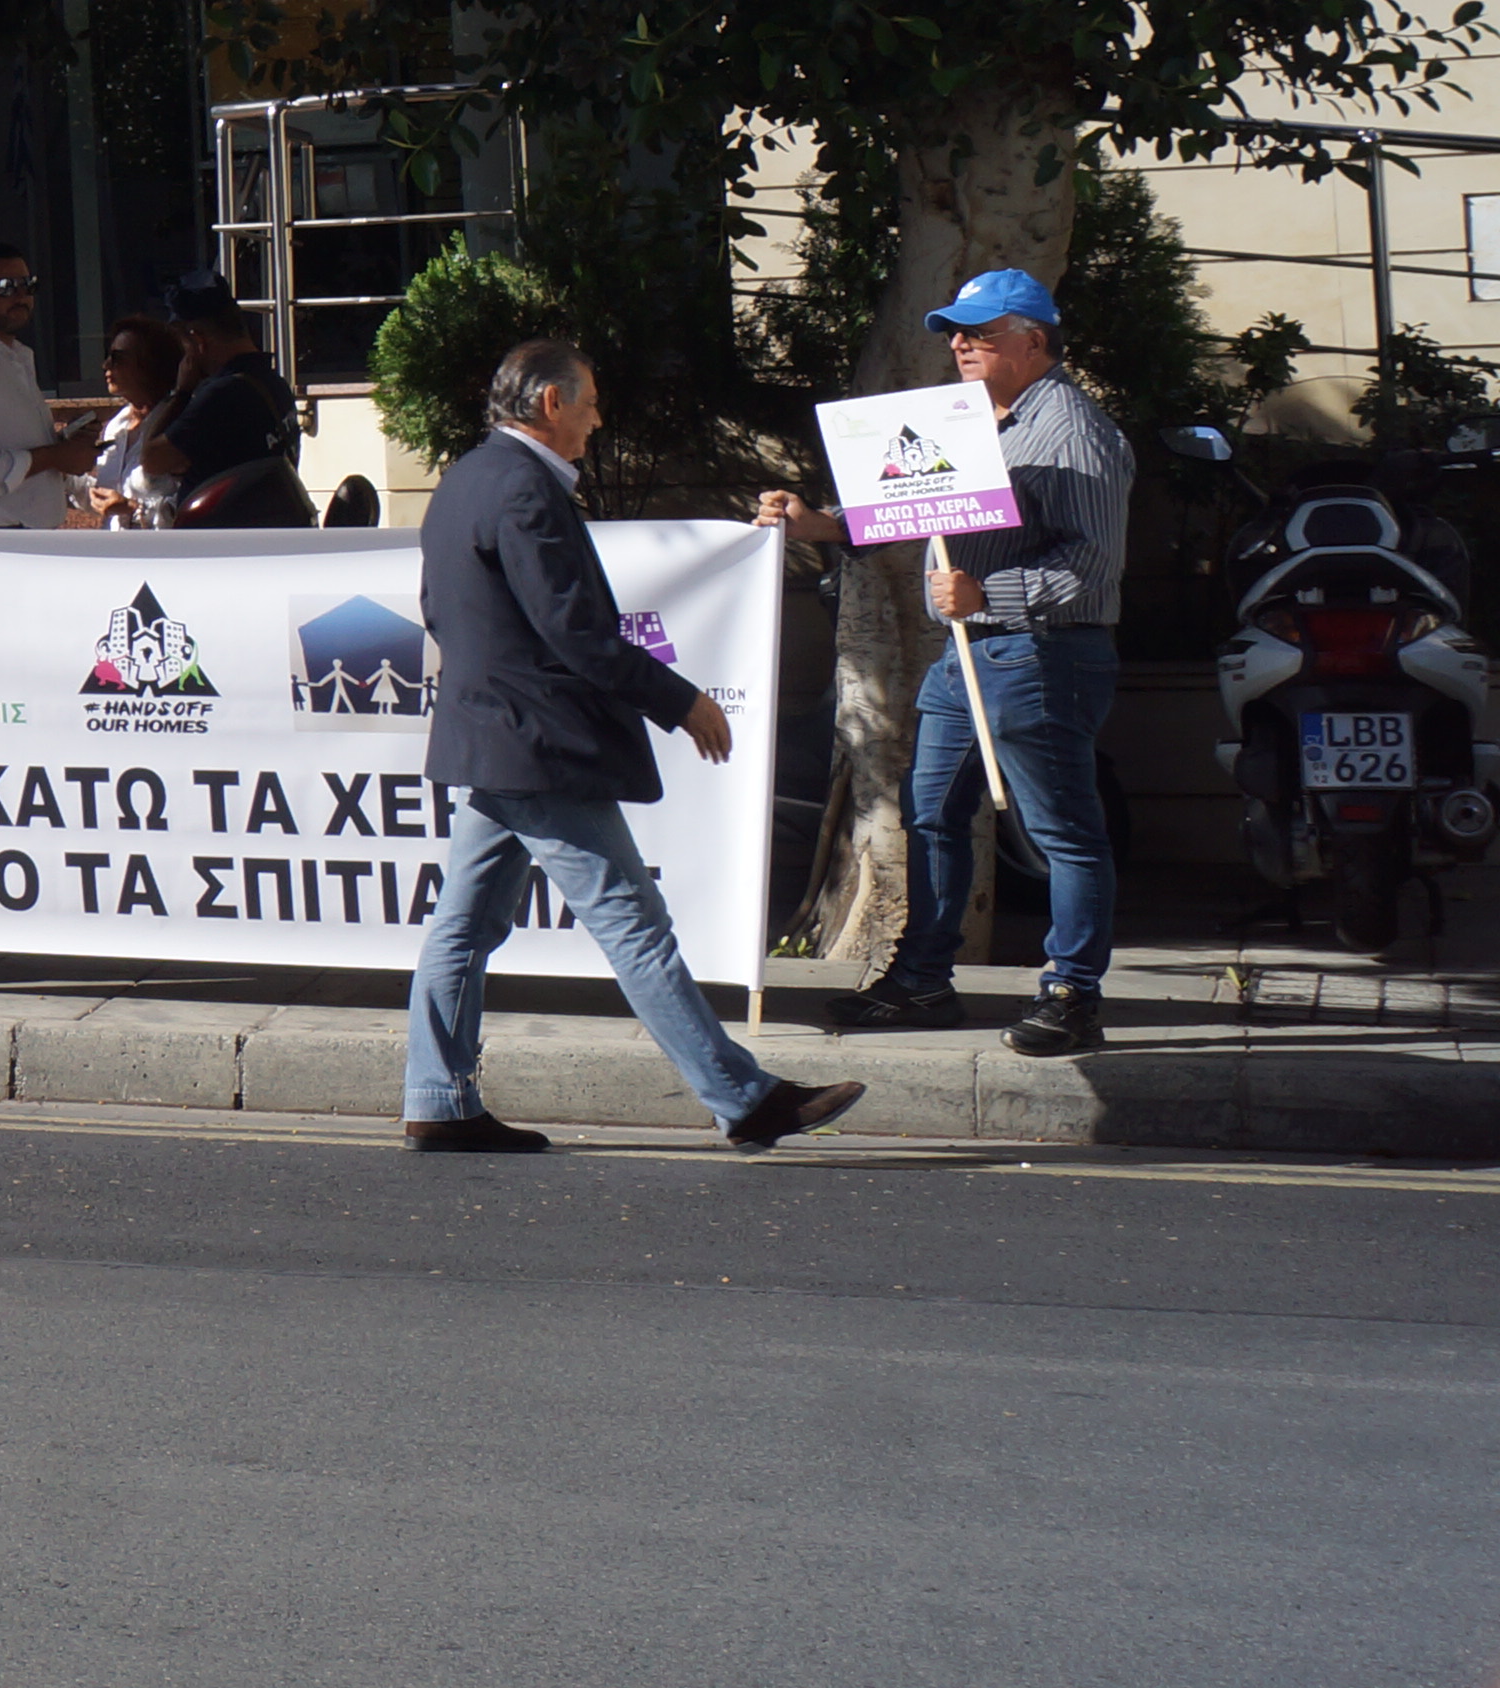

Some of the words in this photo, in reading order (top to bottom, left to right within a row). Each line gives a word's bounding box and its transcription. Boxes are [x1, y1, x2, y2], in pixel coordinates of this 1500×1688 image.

[863, 523, 895, 540] ΑΠΟ
[897, 521, 917, 535] ΤΑ
[919, 514, 968, 533] ΣΠΙΤΙΑ
[970, 509, 1006, 527] ΜΑΣ
[874, 506, 913, 523] ΚΑΤΩ
[914, 502, 934, 517] ΤΑ
[936, 497, 981, 514] ΧΕΡΙΑ
[724, 704, 746, 715] CITY
[86, 718, 129, 733] OUR
[134, 719, 209, 734] HOMES
[1325, 716, 1404, 747] LBB
[1335, 753, 1407, 783] 626
[192, 769, 299, 836] ΤΑ
[321, 772, 458, 839] ΧΕΡ
[63, 851, 170, 918] ΤΑ
[192, 856, 445, 929] ΣΠΙΤΙΑ
